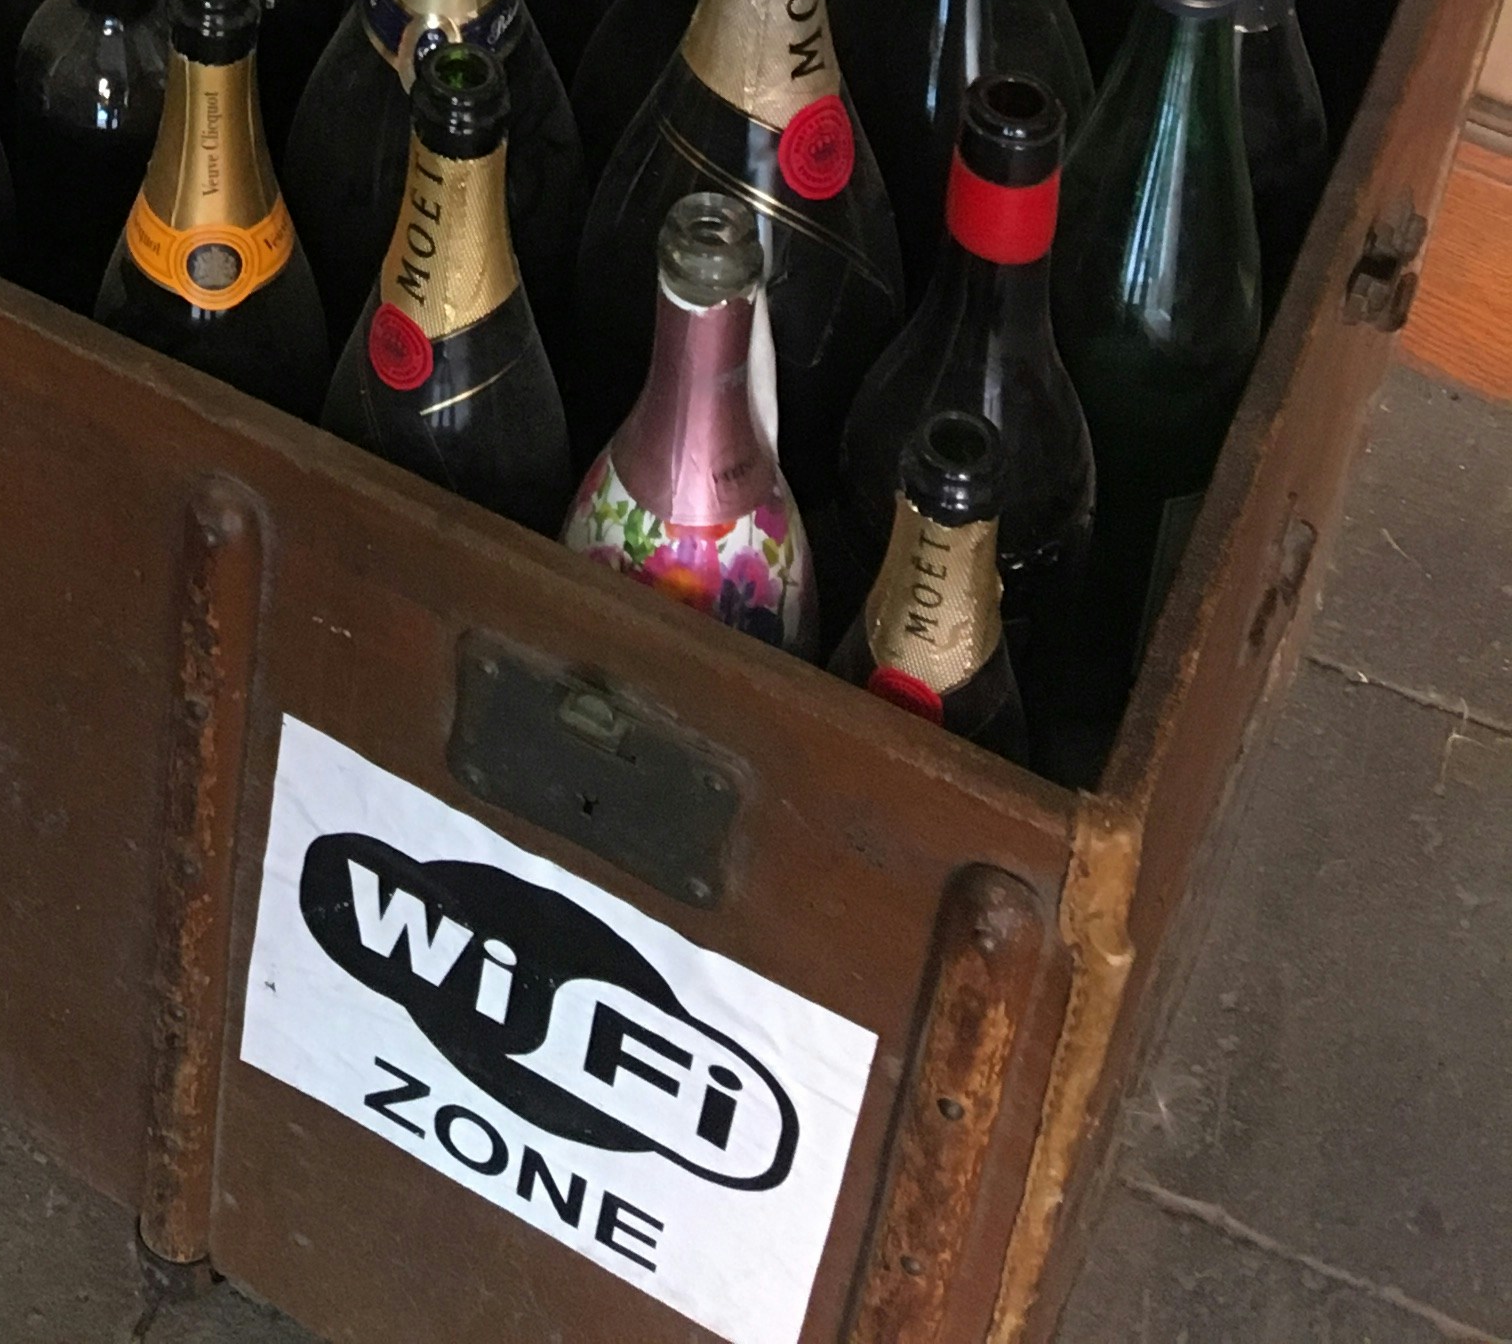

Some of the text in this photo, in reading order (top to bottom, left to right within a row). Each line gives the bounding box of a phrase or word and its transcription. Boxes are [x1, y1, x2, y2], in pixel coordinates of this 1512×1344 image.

[200, 90, 223, 197] Veuve Clicquot
[362, 1055, 666, 1274] ZONE
